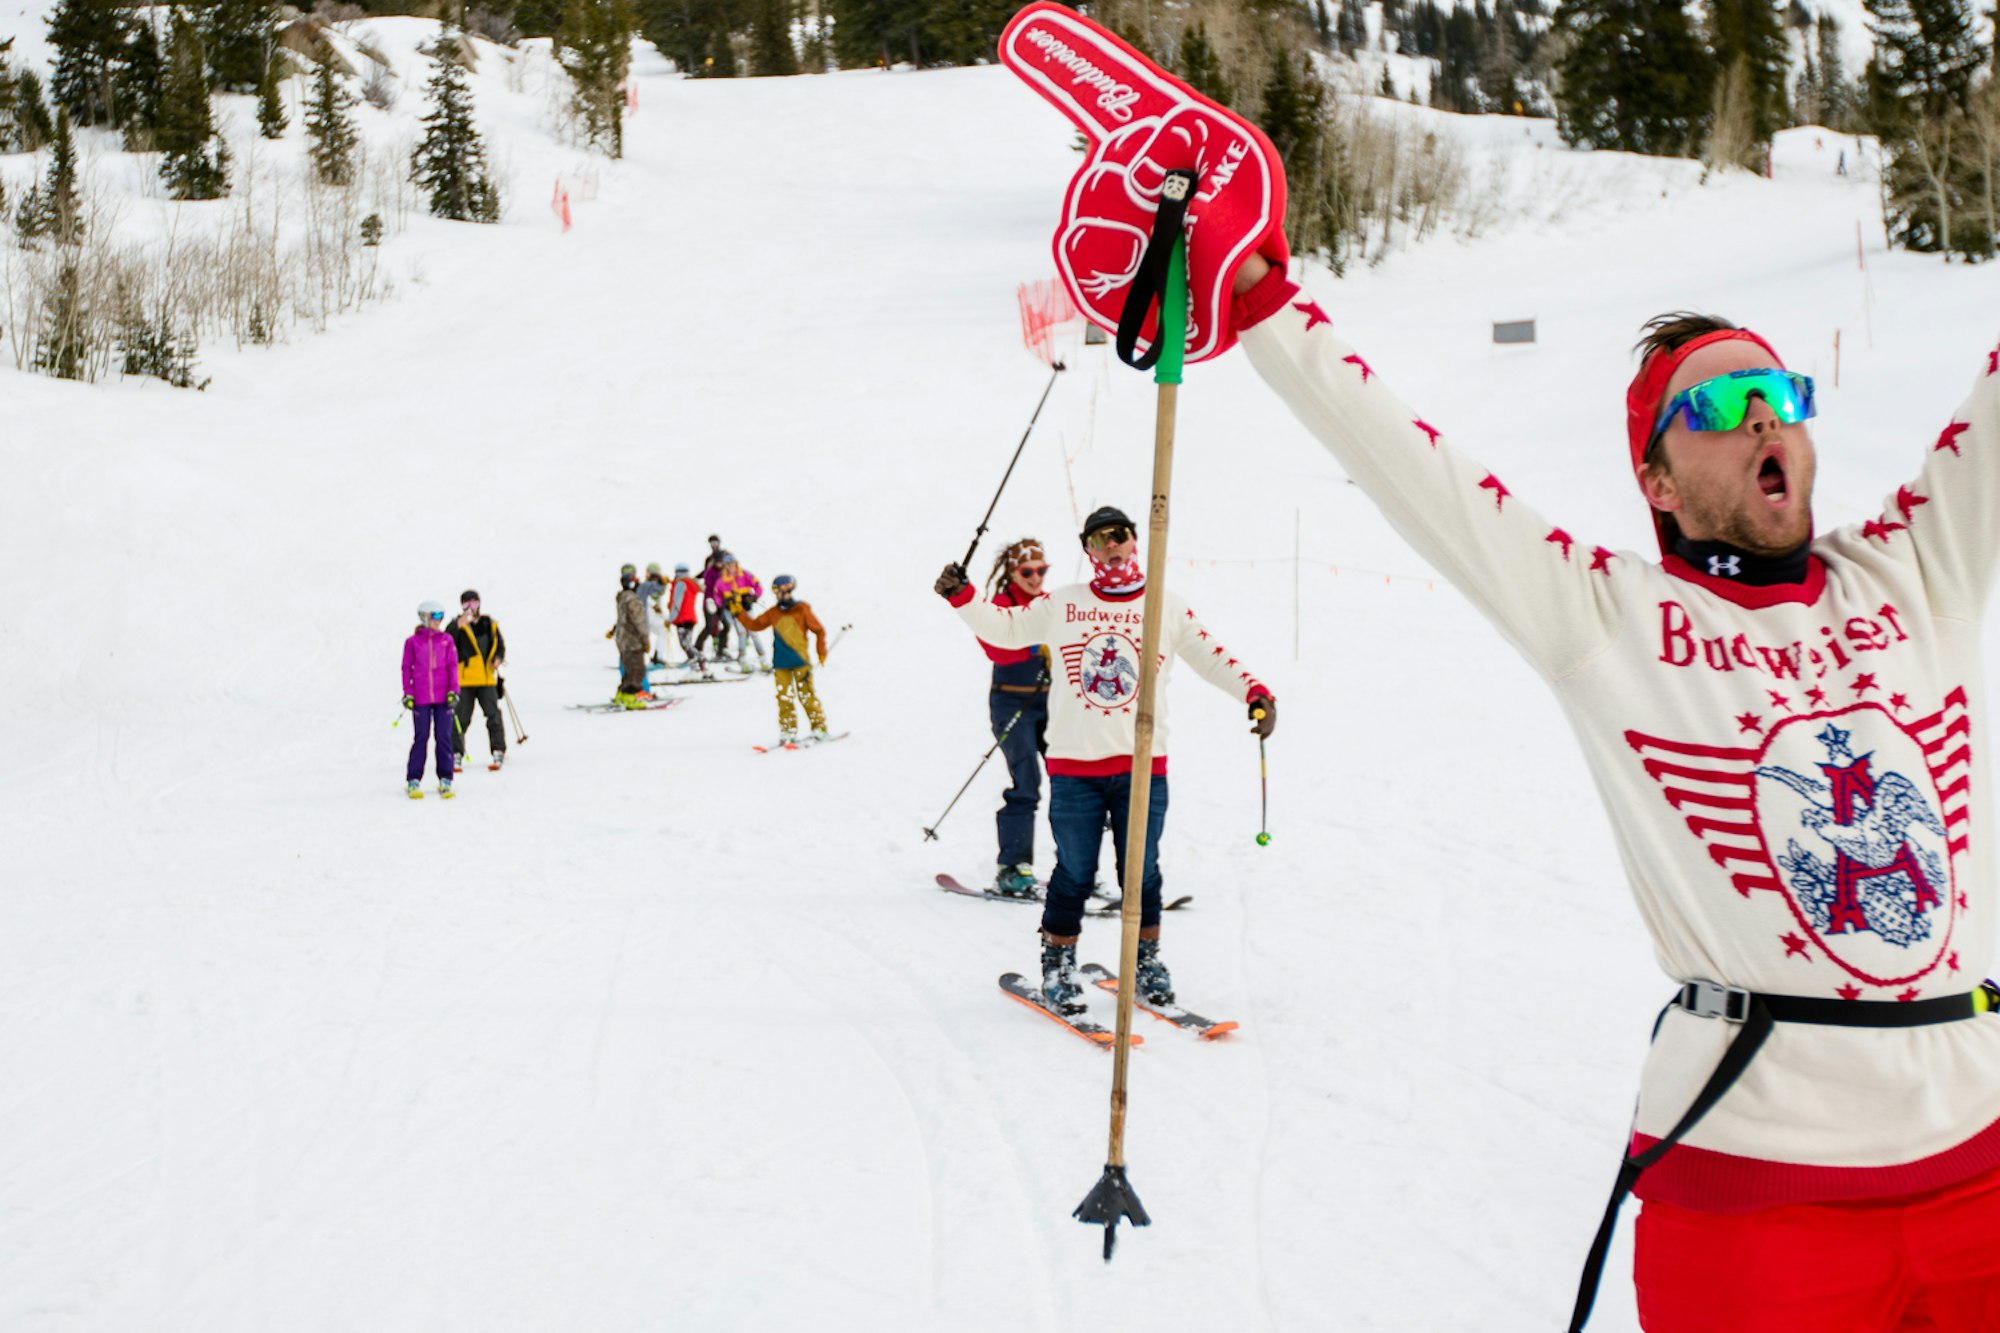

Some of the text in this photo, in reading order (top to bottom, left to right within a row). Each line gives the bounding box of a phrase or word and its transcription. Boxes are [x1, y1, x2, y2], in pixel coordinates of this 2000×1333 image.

[1026, 27, 1141, 123] Budweiser
[1194, 139, 1249, 203] LAKE
[1065, 603, 1143, 625] Budweis
